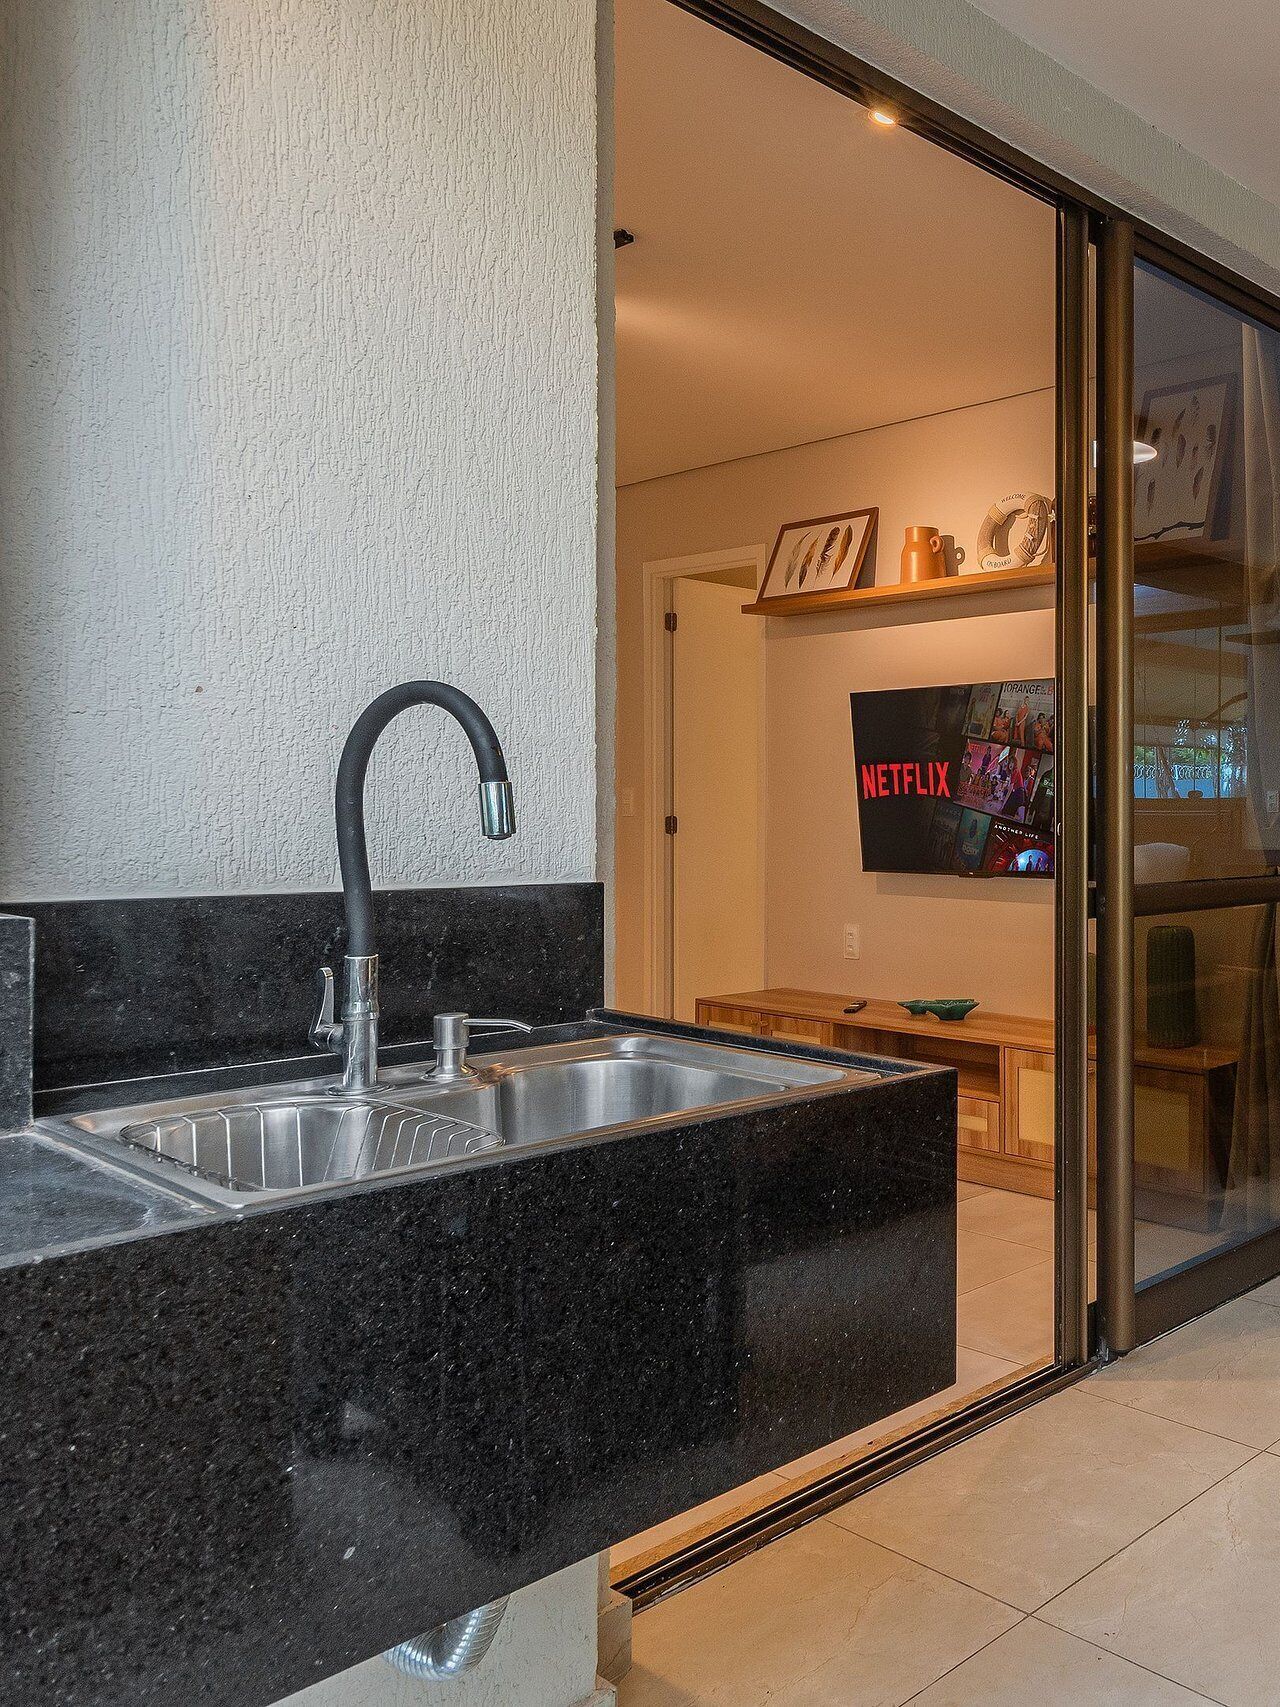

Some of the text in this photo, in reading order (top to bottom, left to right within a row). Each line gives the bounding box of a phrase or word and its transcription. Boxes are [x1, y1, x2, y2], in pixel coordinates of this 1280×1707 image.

[1001, 493, 1026, 503] WELCOME
[993, 558, 1012, 568] BOARD
[1006, 683, 1041, 695] ORANGE
[861, 762, 951, 799] NETFLIX
[994, 824, 1040, 840] ANOTHER LIFE
